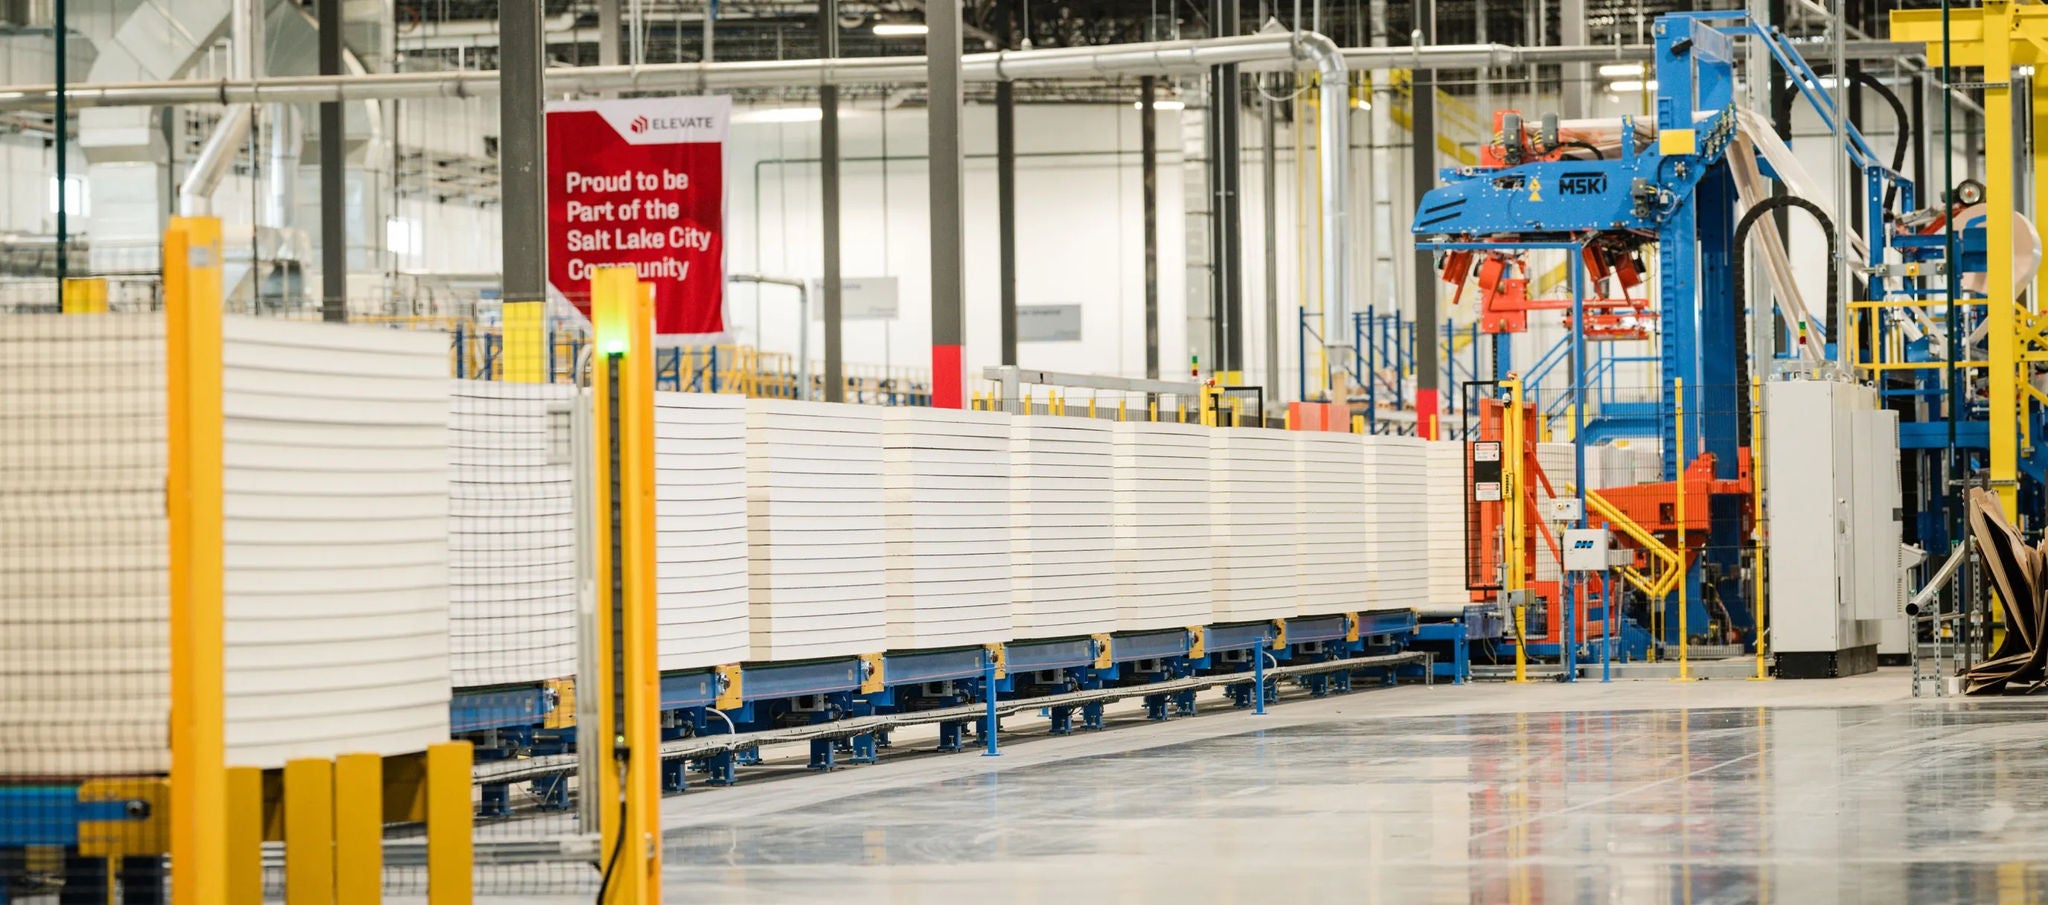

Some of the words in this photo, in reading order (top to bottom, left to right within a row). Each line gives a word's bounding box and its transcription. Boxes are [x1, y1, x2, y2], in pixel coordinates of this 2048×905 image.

[652, 116, 714, 130] ELEVATE
[566, 170, 632, 194] Proud
[635, 171, 659, 191] to
[663, 168, 689, 190] be
[567, 200, 615, 223] Part
[618, 198, 642, 220] of
[644, 198, 680, 220] the
[567, 228, 612, 252] Salt
[615, 227, 666, 250] Lake
[669, 226, 712, 252] City
[568, 256, 690, 281] Counity
